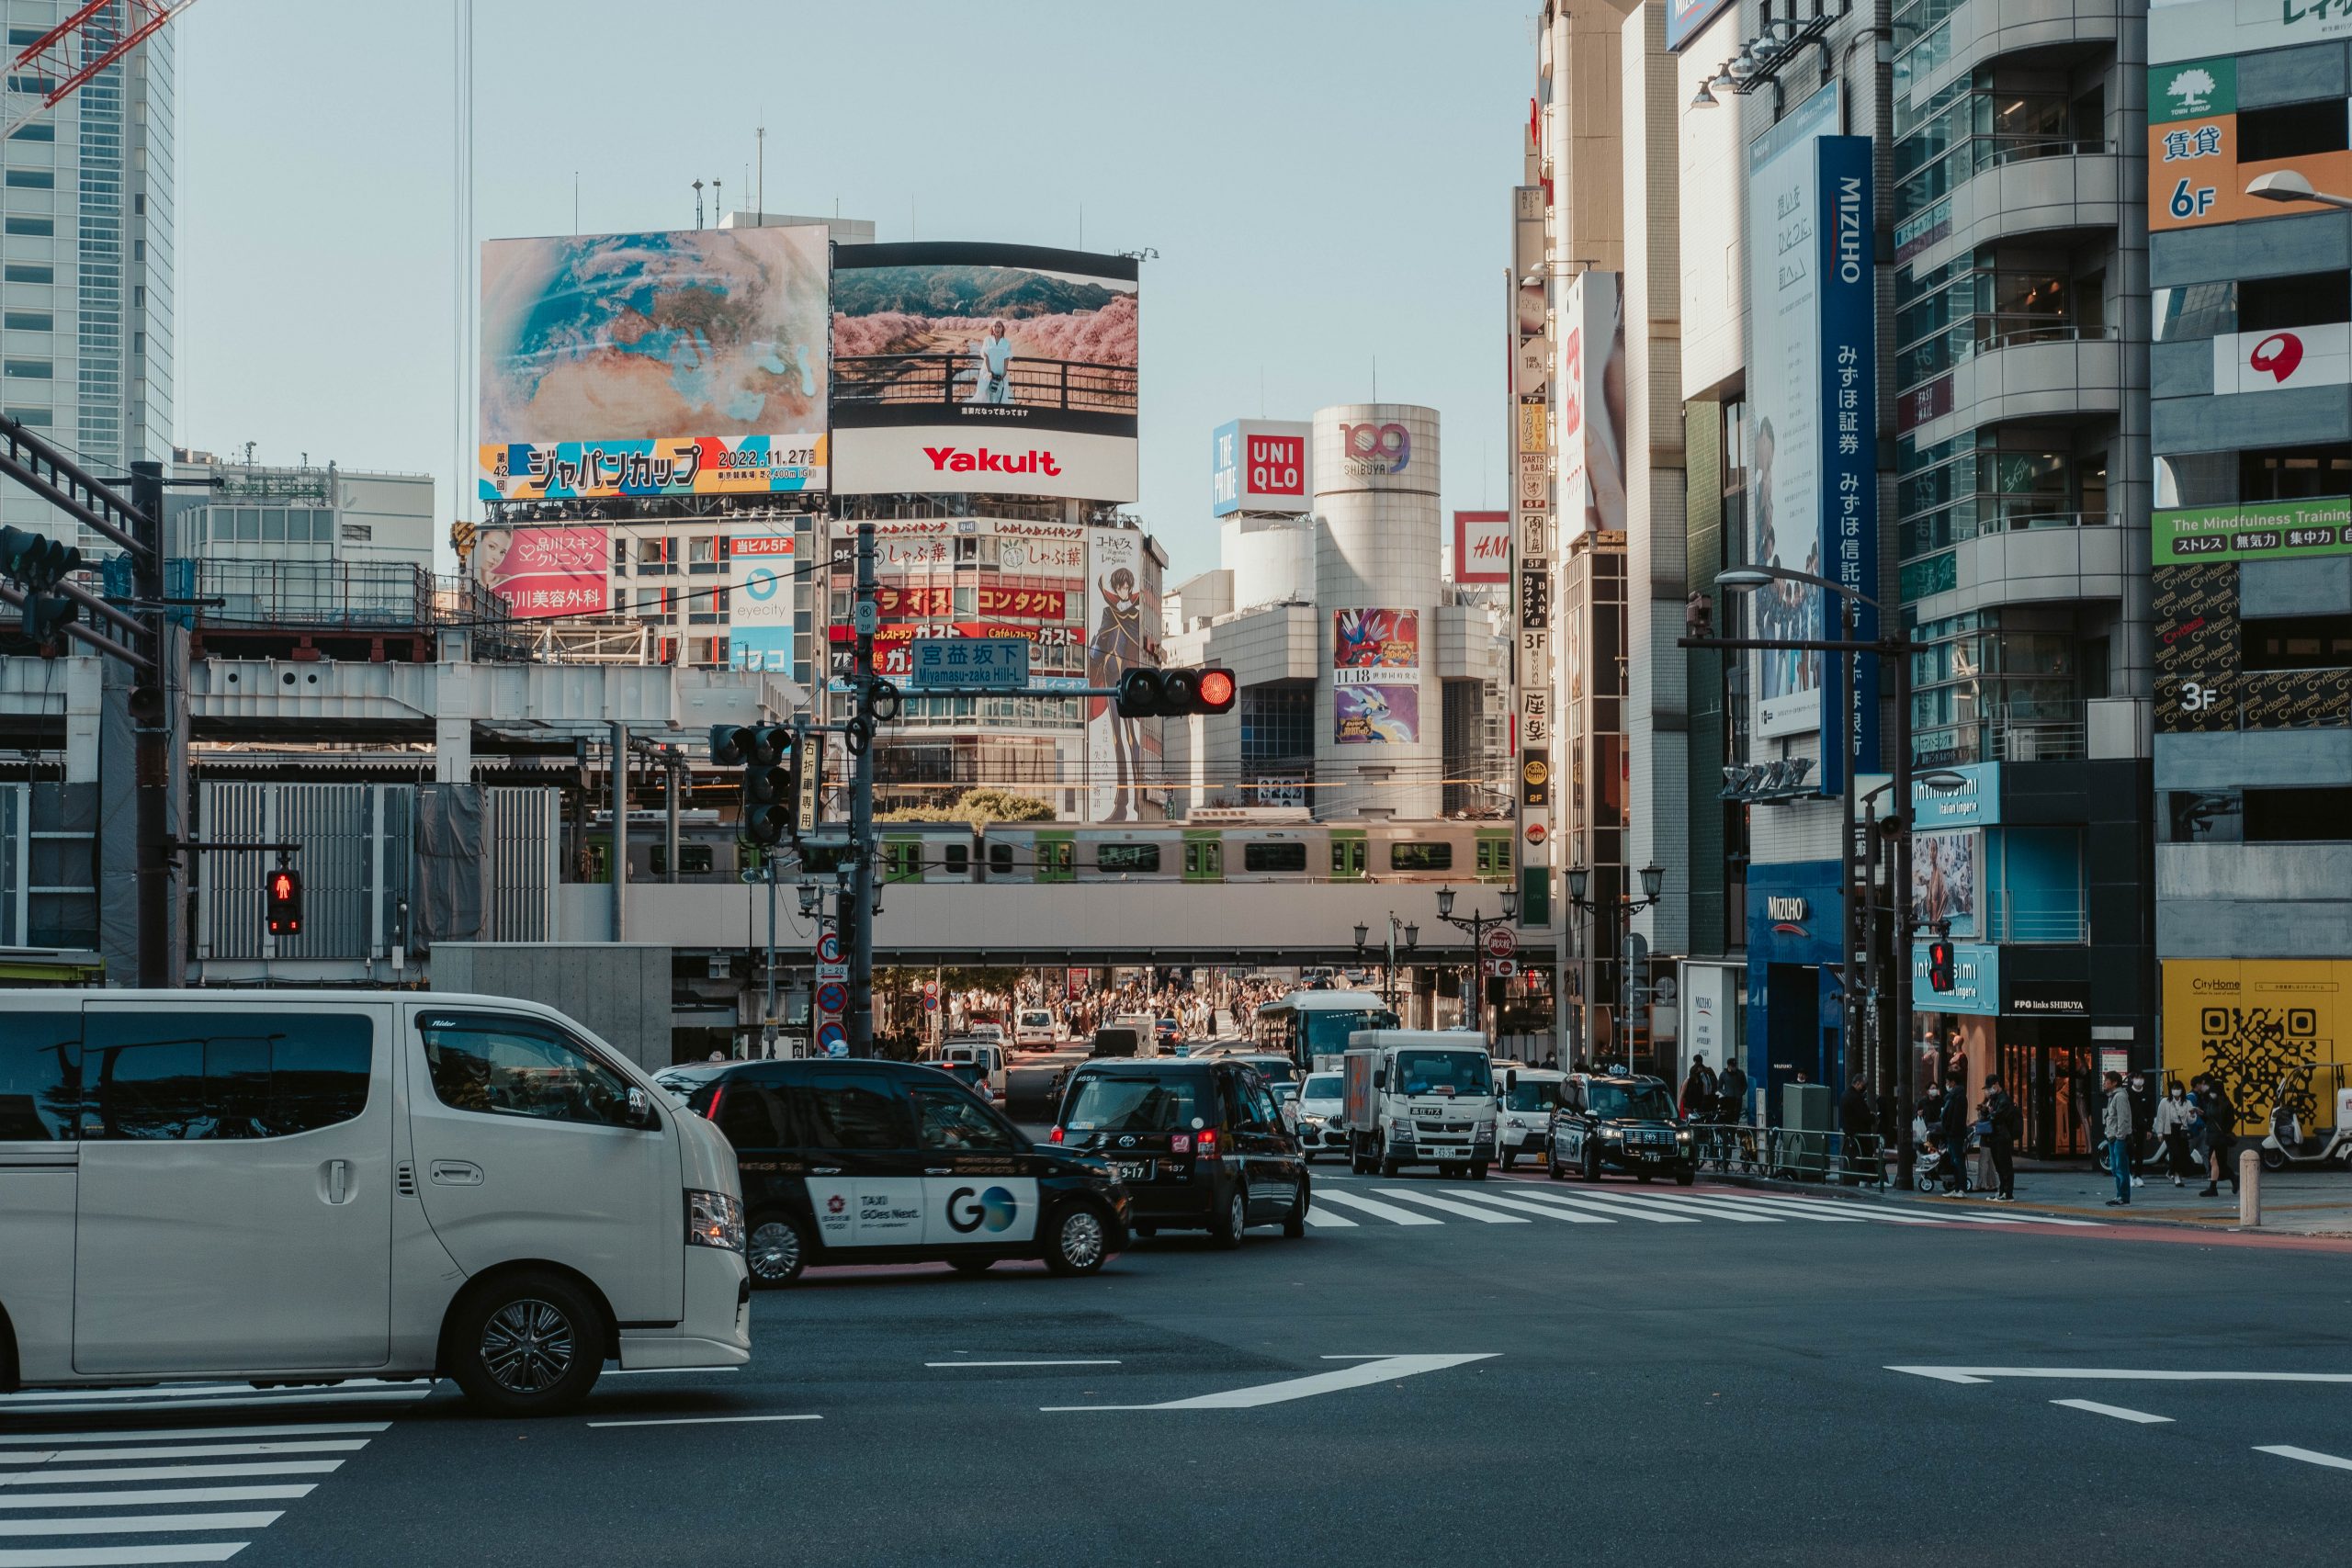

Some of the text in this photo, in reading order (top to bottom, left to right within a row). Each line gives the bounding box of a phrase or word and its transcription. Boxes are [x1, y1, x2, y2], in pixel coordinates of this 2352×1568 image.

[2190, 105, 2211, 114] GROUP
[2164, 126, 2222, 161] 賃貸
[2170, 179, 2215, 219] 6F
[1839, 177, 1860, 284] MIZUHO
[1526, 396, 1540, 404] 7F
[1838, 344, 1859, 454] みずほ証券
[1918, 388, 1933, 405] FAST
[1918, 408, 1933, 423] NAIL
[718, 449, 809, 468] 2022.11.27
[1218, 433, 1233, 468] THE
[1253, 442, 1295, 464] UNI
[1339, 423, 1411, 474] 109
[527, 444, 702, 491] ジャパンカップ
[922, 447, 1062, 477] Yakult
[1343, 464, 1386, 475] SHIBUYA
[1521, 456, 1544, 464] DARTS
[1531, 464, 1544, 472] BAR
[1215, 467, 1238, 506] PRIME
[1253, 466, 1298, 491] QLO
[993, 522, 1084, 539] しゃぶしゃぶバイキング
[2172, 509, 2352, 532] The Mindfulness Training
[537, 536, 603, 552] 品川スキン
[736, 537, 788, 553] 当ビル5F
[1473, 535, 1510, 559] H&M
[2177, 537, 2222, 551] ストレス
[2235, 533, 2277, 548] 無気力
[2289, 529, 2332, 545] 集中力
[536, 551, 595, 567] クリニック
[888, 542, 947, 563] しゃぶ葉
[1029, 545, 1081, 567] しゃぶ葉
[1527, 558, 1541, 568] 5F
[502, 588, 601, 610] 品川美容外科
[978, 590, 1063, 615] コンタクト
[1523, 575, 1534, 619] カラオケ
[1538, 581, 1546, 615] BAR
[2163, 589, 2205, 617] CityHome
[2191, 587, 2233, 615] CityHome
[738, 603, 786, 618] eyecity
[1530, 618, 1541, 626] 4F
[2163, 615, 2206, 644] CityHome
[2191, 615, 2233, 643] CityHome
[1038, 626, 1078, 646] ガスト
[1524, 634, 1546, 649] 3F
[886, 647, 911, 673] ガ
[922, 644, 1019, 665] 宮益坂下
[2164, 643, 2206, 671] CityHome
[2191, 641, 2234, 670] CityHome
[919, 668, 990, 685] Miyamasu-zaka
[993, 667, 1023, 682] Hill-L.
[1336, 669, 1371, 684] 11.18
[2181, 682, 2217, 711] 3F
[1526, 766, 1545, 774] Public
[800, 740, 815, 828] 右折車専用
[1529, 794, 1543, 803] 2F
[1939, 800, 1977, 815] Italian lingerie
[1768, 897, 1804, 920] MIZUHO
[1489, 938, 1511, 950] 消火栓
[1915, 958, 1976, 980] intsimi
[1955, 984, 1976, 999] lingerie
[2192, 977, 2240, 990] CityHome
[1694, 995, 1713, 1010] MIZUHO
[2014, 1000, 2084, 1010] FPG links SHIBUYA
[861, 1195, 888, 1206] TAXI
[860, 1209, 889, 1220] GOes
